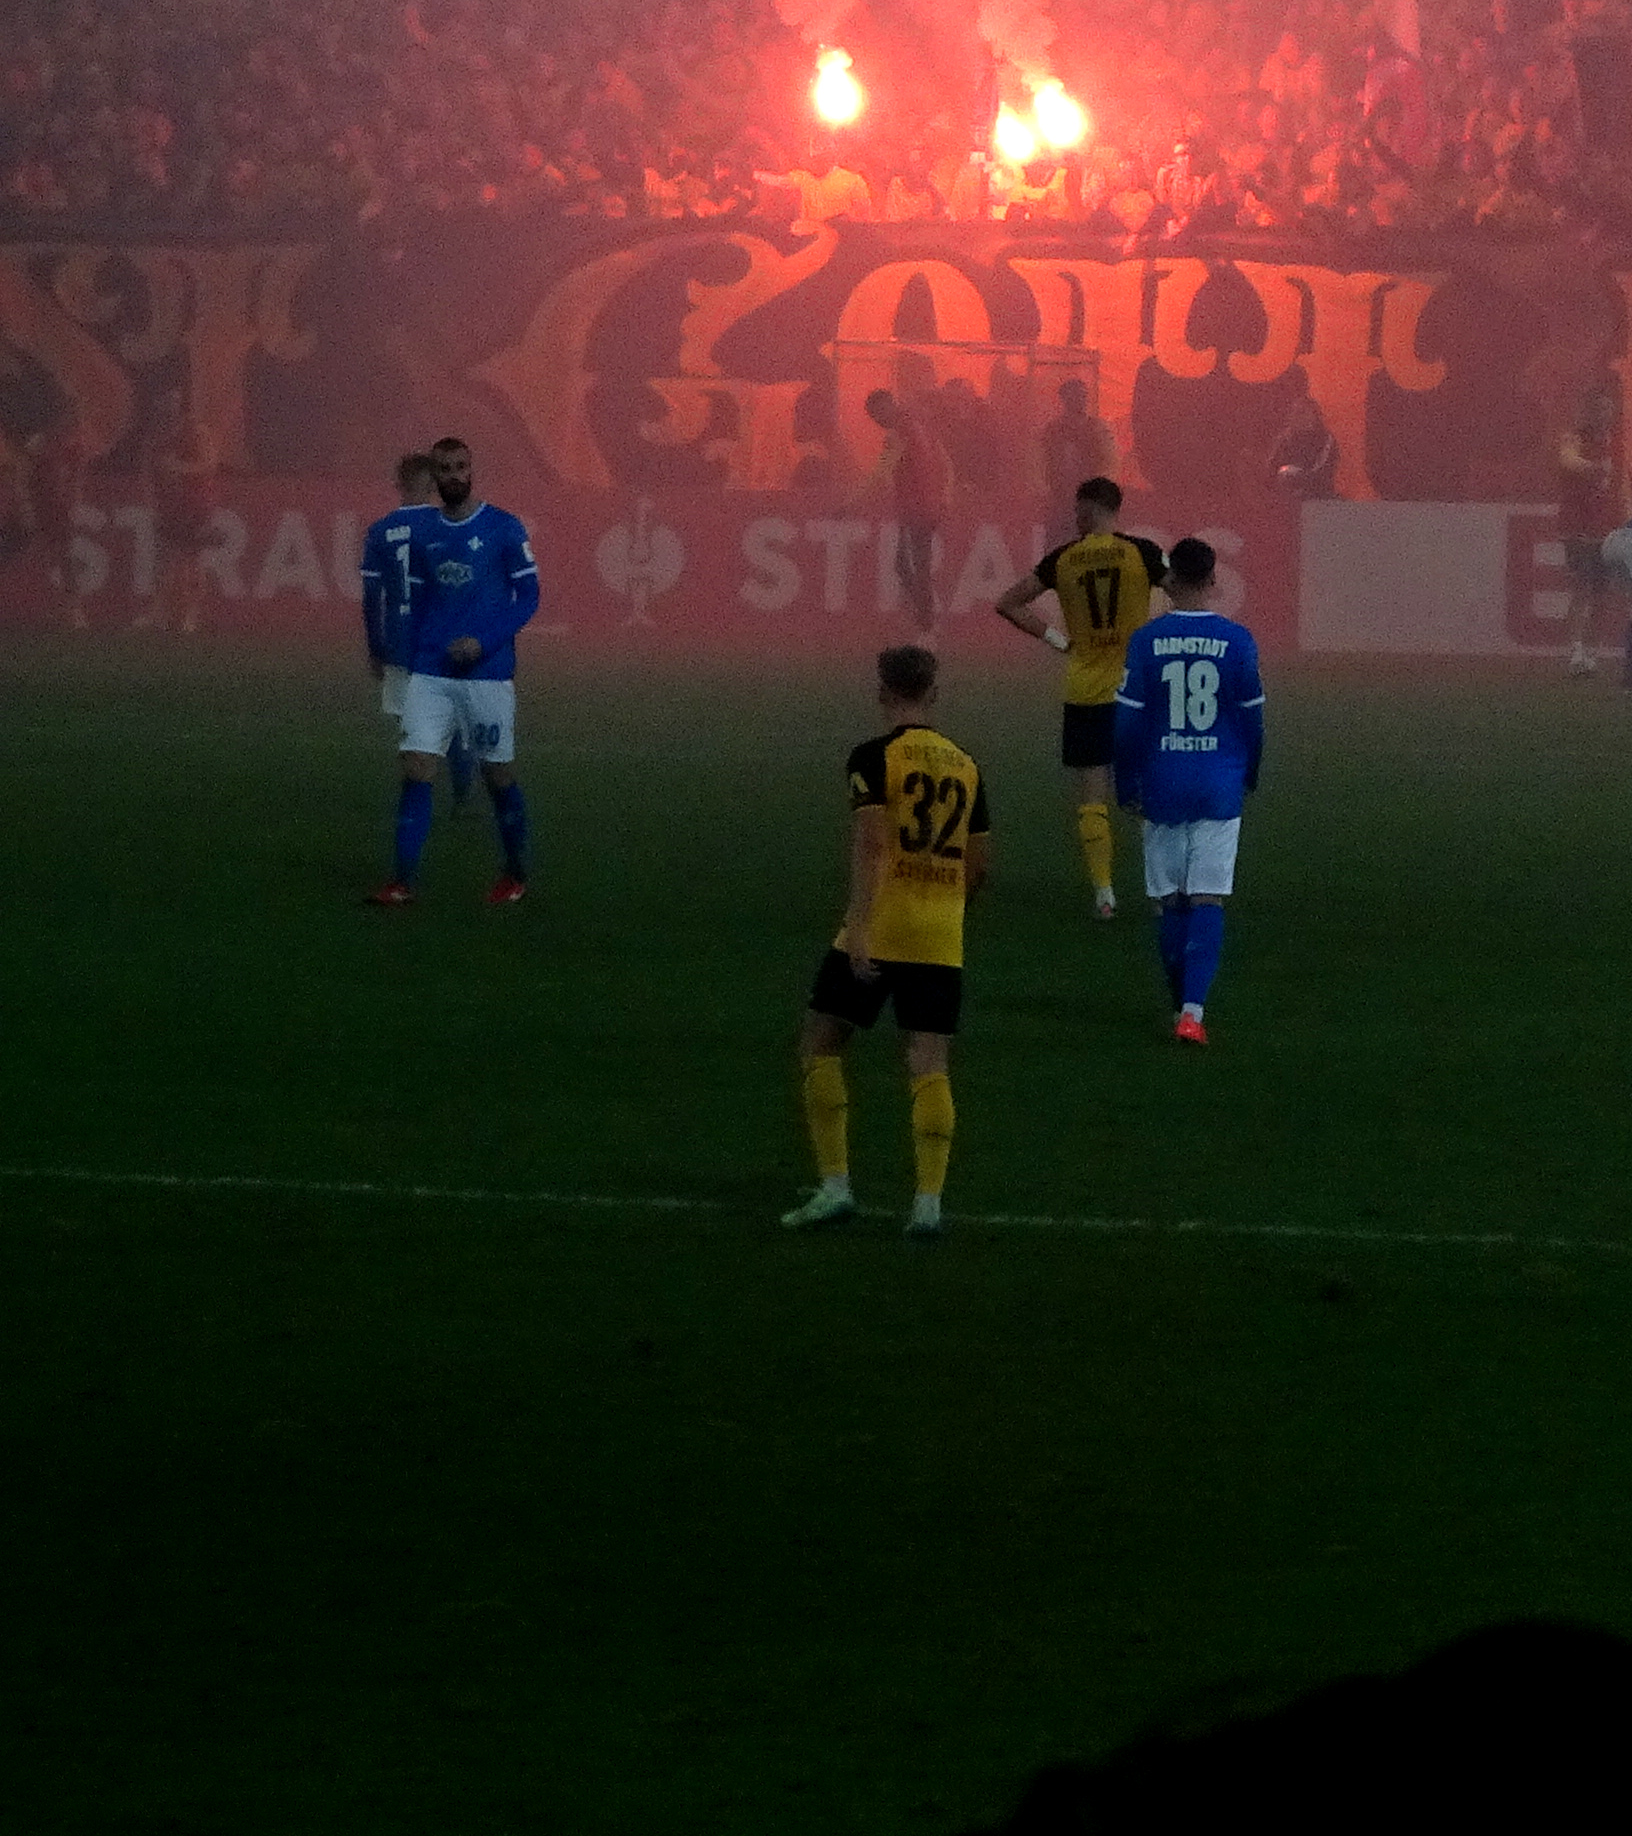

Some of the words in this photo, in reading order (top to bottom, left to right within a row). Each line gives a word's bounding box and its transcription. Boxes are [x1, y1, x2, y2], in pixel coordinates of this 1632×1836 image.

[1078, 566, 1121, 630] 17
[1153, 636, 1230, 659] DARMSTADT
[1161, 660, 1220, 731] 18
[899, 771, 967, 853] 32
